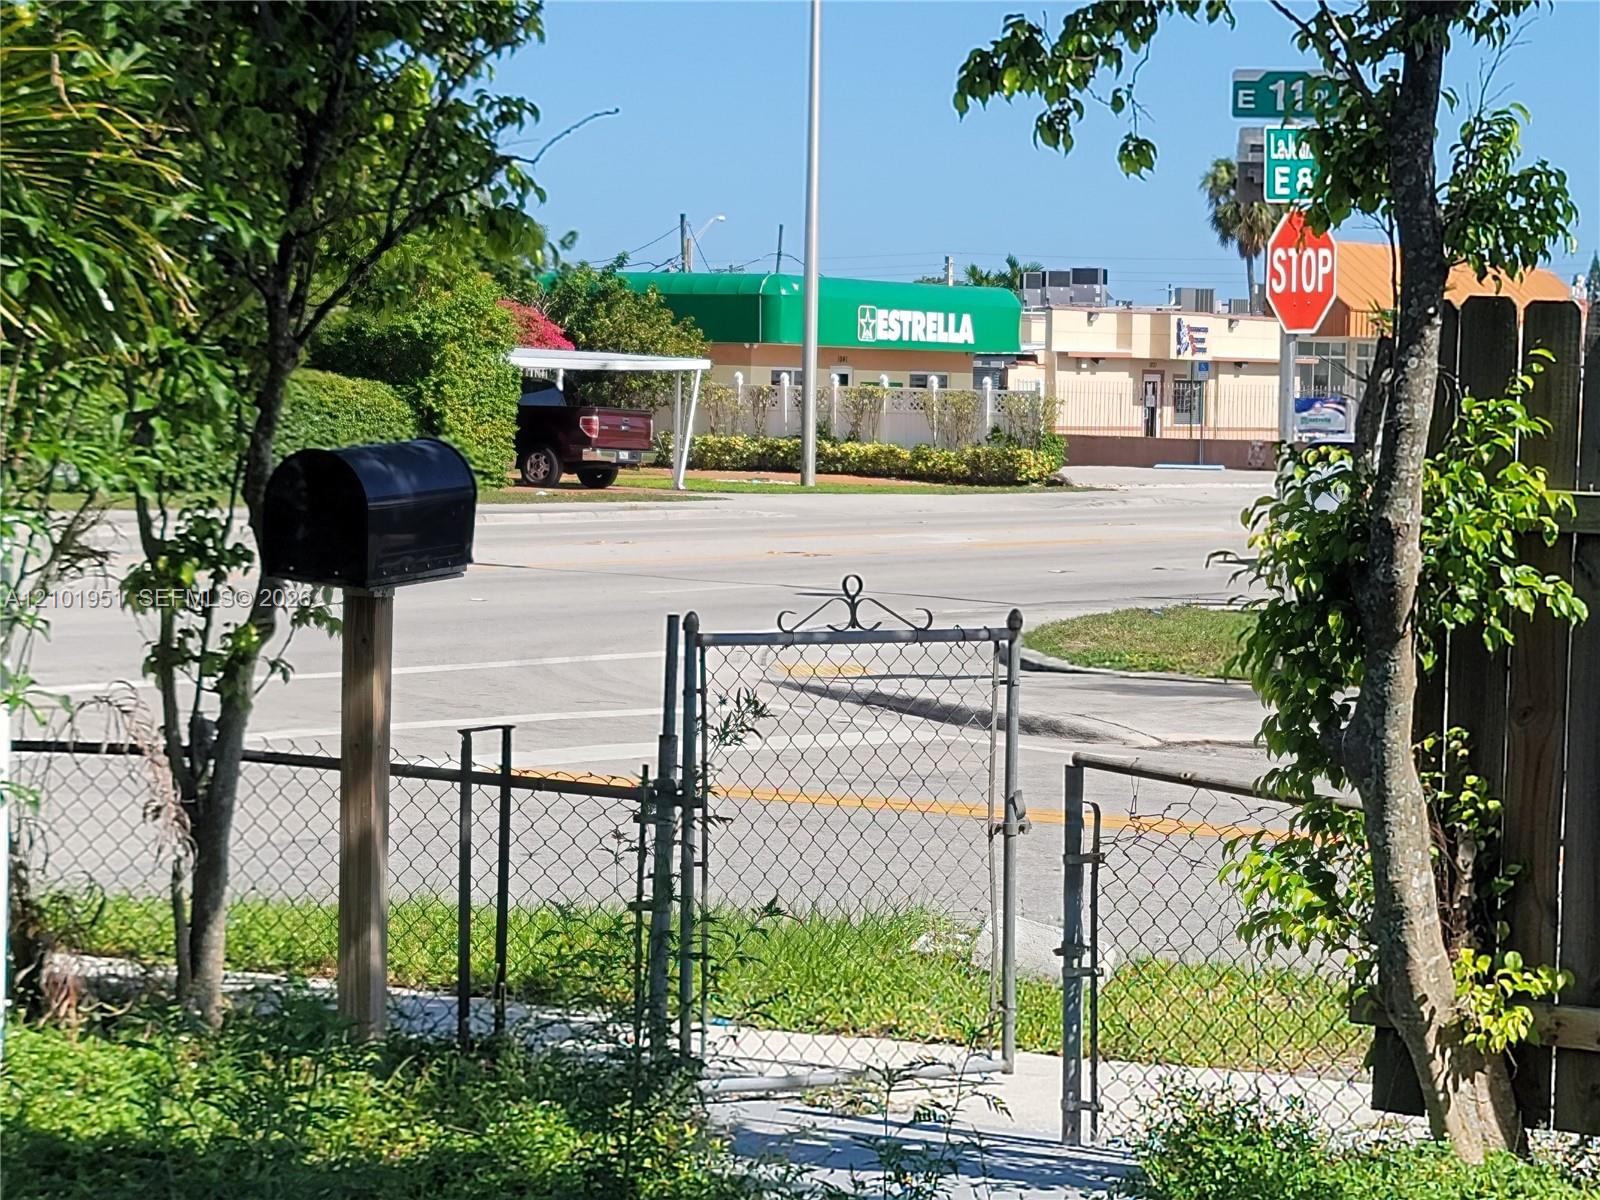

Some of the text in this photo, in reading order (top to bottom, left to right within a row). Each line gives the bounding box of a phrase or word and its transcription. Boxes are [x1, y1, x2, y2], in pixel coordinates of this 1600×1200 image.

[1238, 89, 1255, 109] E
[1268, 79, 1304, 112] 11
[1275, 166, 1314, 195] E 8
[1271, 247, 1333, 294] STOP
[877, 308, 975, 345] ESTRELLA
